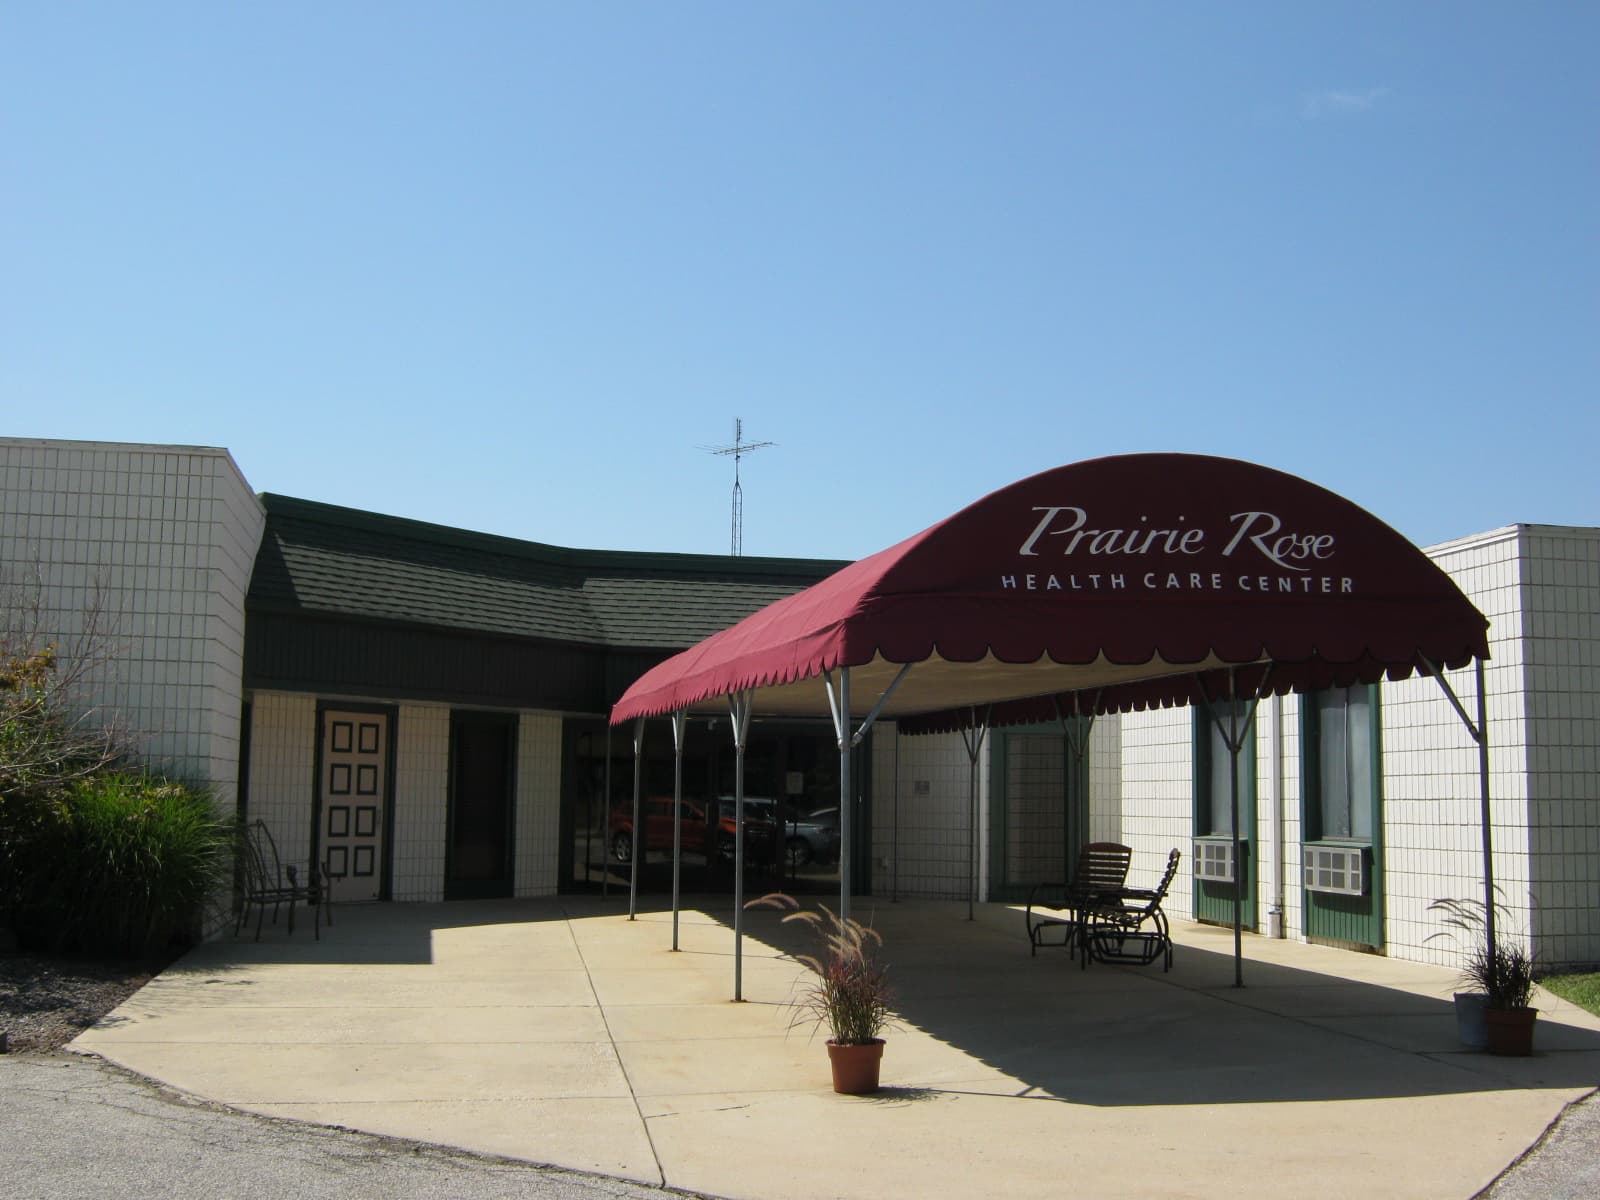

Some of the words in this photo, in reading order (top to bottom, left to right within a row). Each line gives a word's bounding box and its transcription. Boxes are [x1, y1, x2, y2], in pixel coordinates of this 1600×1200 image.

[1019, 506, 1204, 555] Prairie
[1221, 511, 1334, 571] Rose
[1001, 574, 1125, 590] HEALTH
[1143, 573, 1222, 589] CARE
[1238, 575, 1353, 593] CENTER
